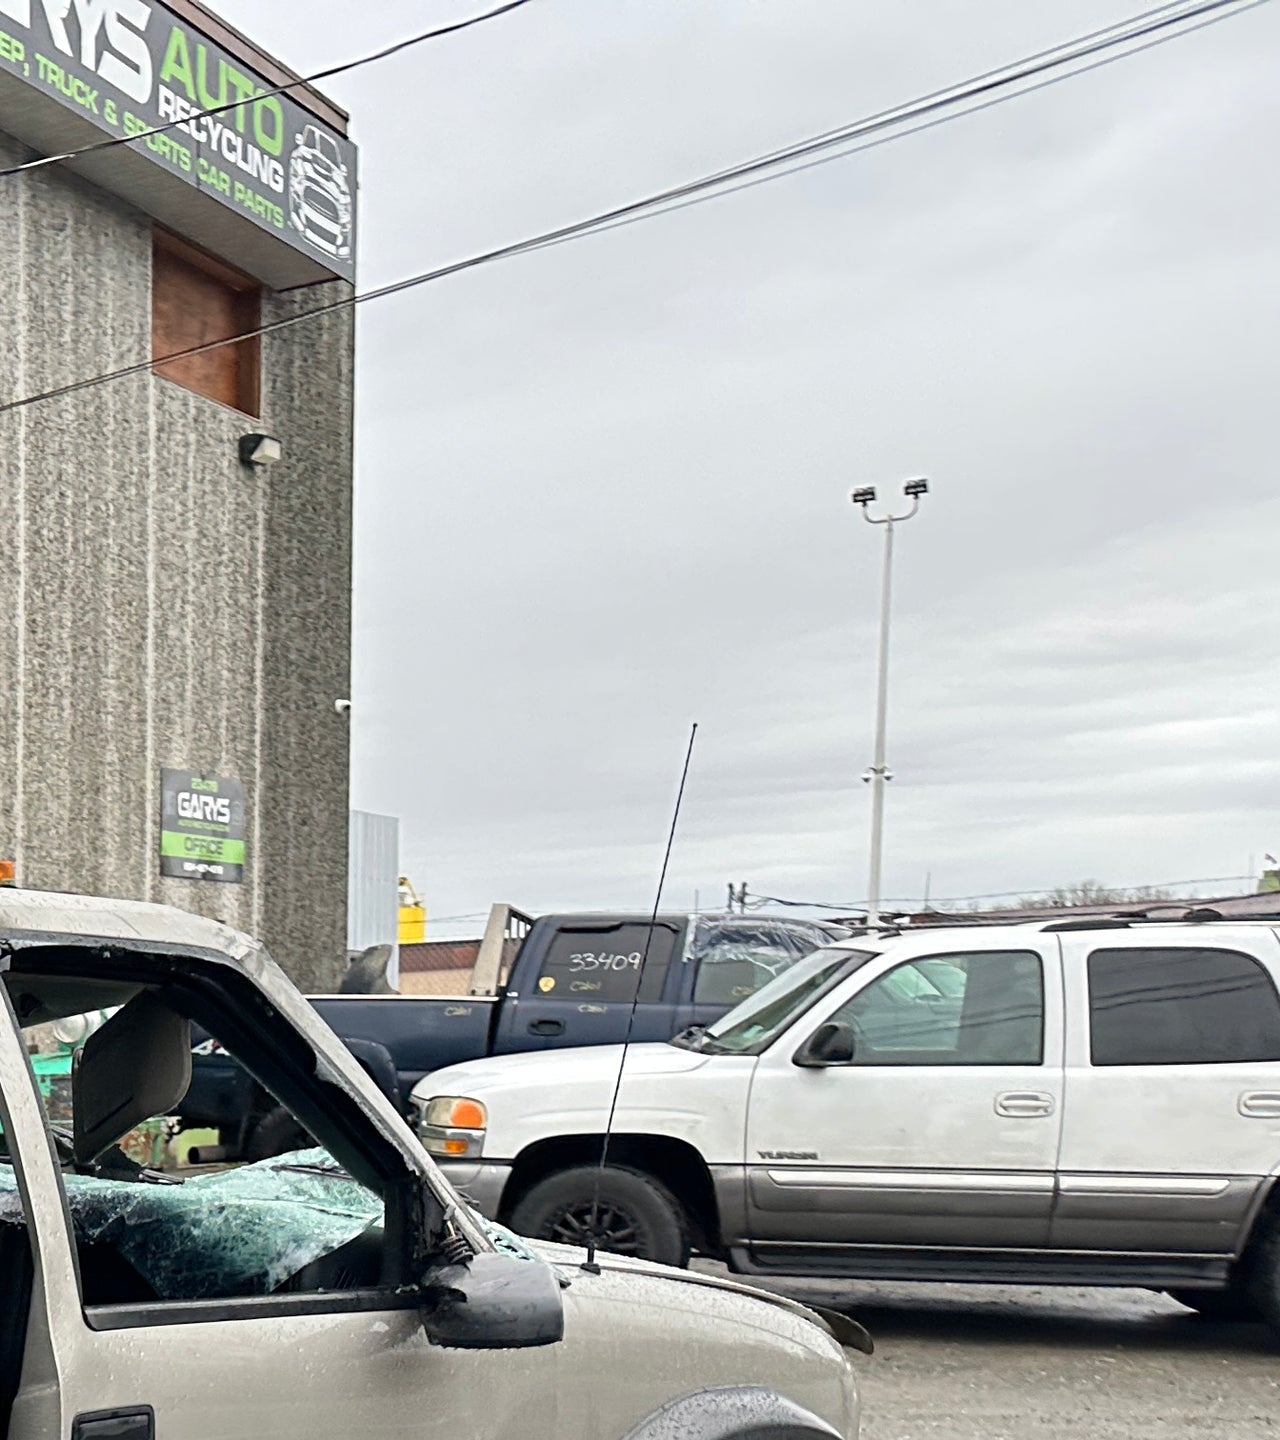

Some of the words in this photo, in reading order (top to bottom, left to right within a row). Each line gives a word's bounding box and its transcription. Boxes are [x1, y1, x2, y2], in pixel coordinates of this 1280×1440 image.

[35, 53, 99, 114] TRUCK
[104, 98, 119, 126] &
[123, 111, 191, 172] SPORTS
[196, 158, 230, 197] CAR
[234, 181, 284, 229] PARTS
[158, 83, 285, 194] RECYCLING
[160, 25, 284, 157] AUTO
[177, 791, 231, 824] GARYS
[569, 952, 641, 972] 33409
